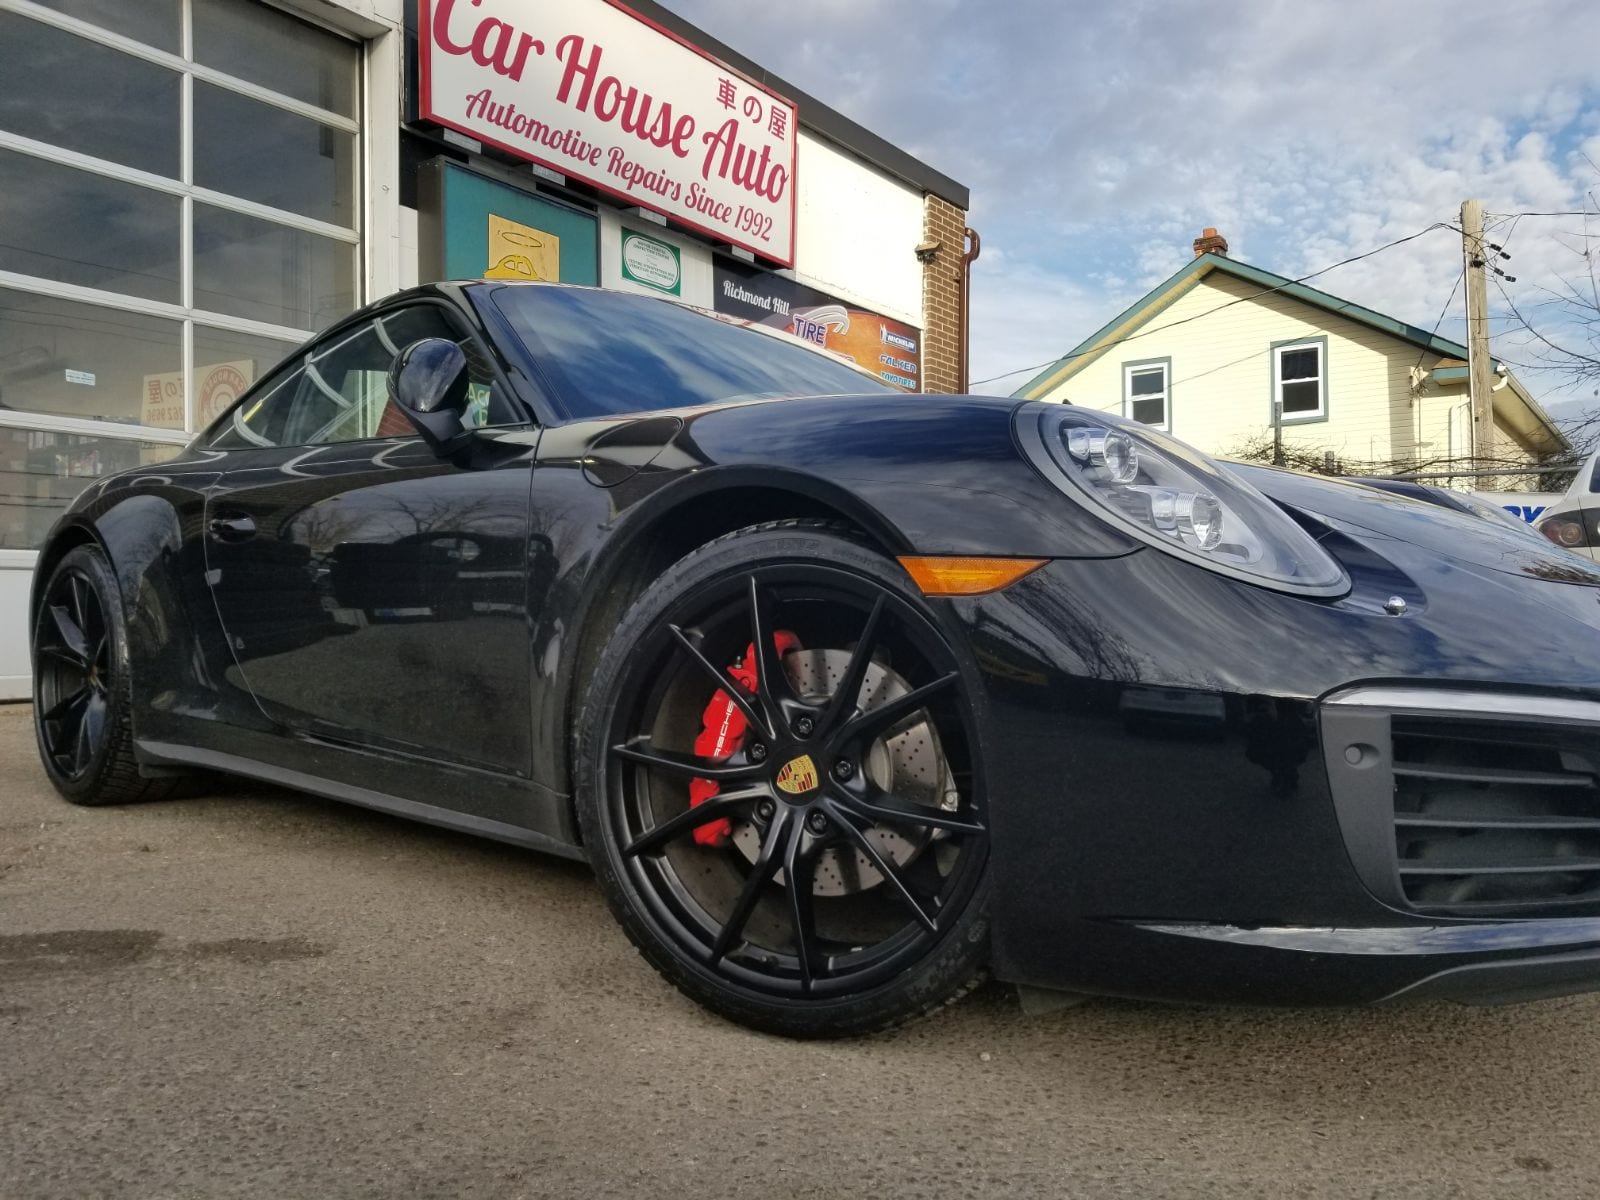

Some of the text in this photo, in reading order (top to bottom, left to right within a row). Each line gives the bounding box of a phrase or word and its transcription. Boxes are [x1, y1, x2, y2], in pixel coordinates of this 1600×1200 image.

[433, 0, 790, 203] Car House Auto
[716, 77, 787, 141] 車の屋
[465, 88, 774, 242] Automotive Repairs Since 1992
[723, 280, 790, 316] Richmond Hill
[795, 317, 826, 344] TIRE
